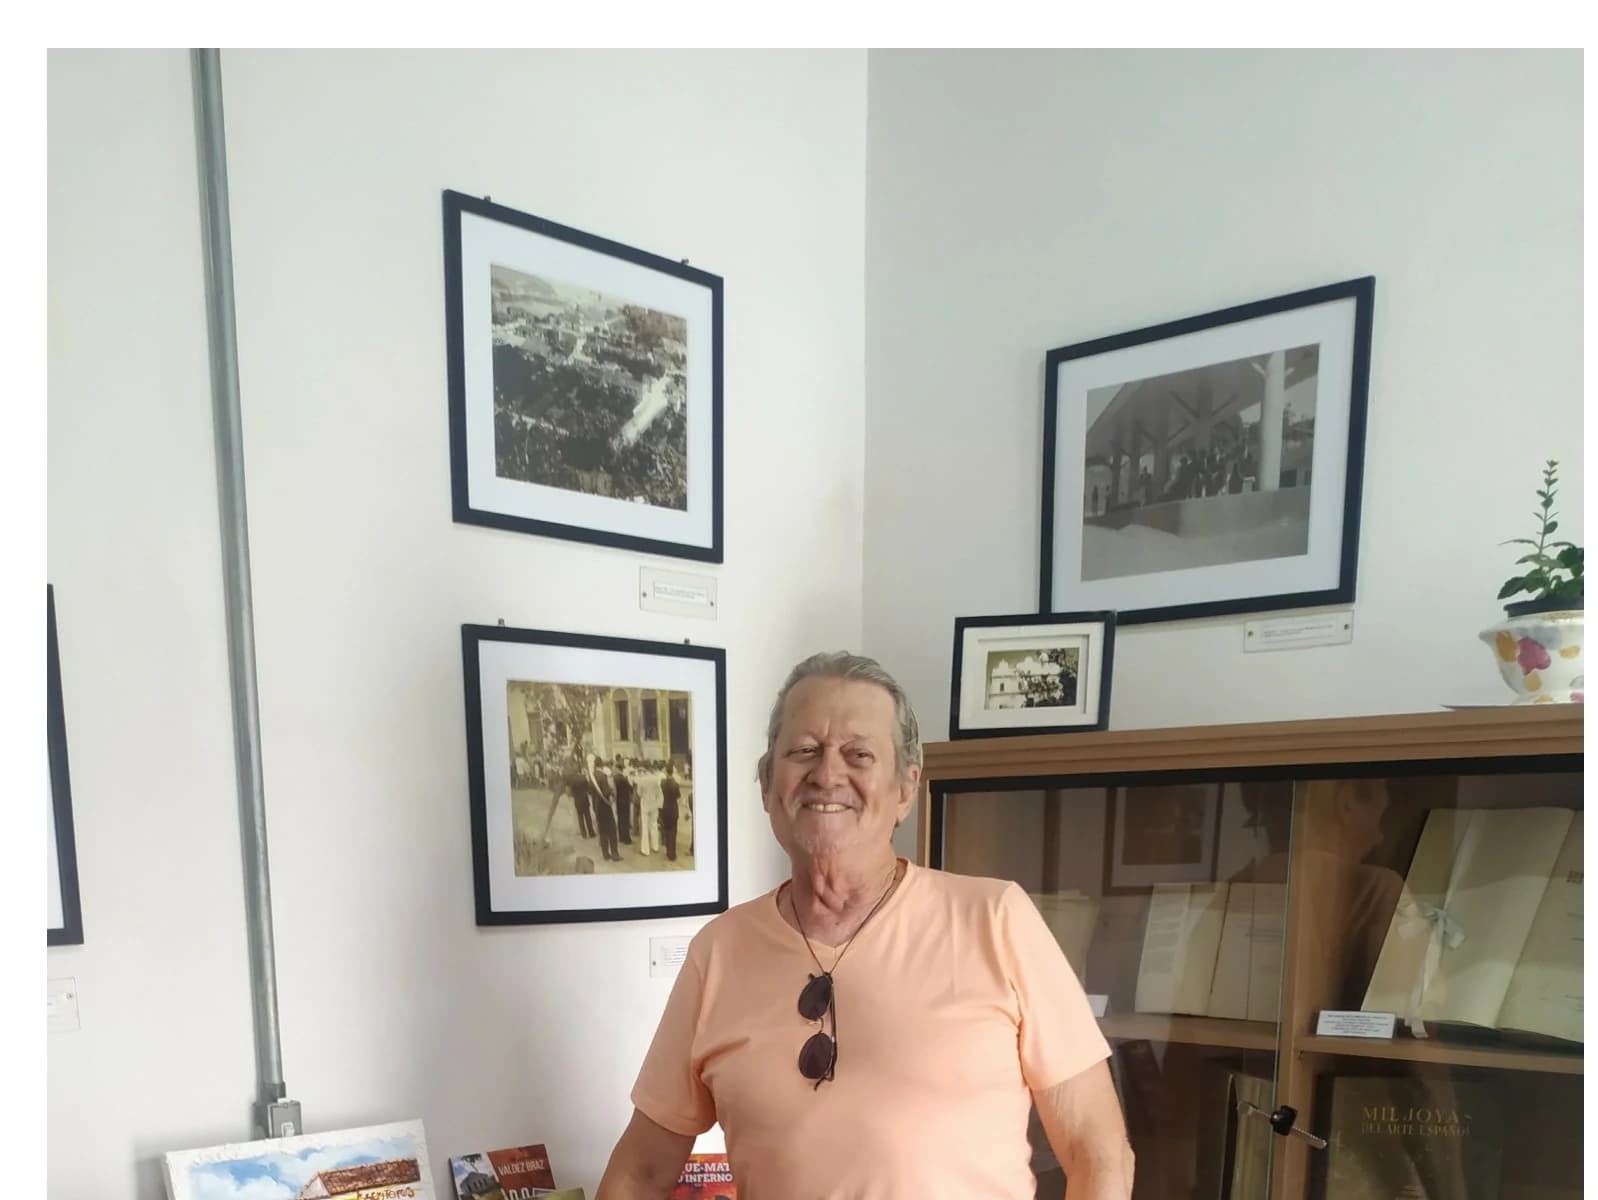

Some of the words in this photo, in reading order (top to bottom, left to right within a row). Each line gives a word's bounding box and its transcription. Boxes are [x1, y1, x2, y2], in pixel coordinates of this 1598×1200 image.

[1362, 1106, 1400, 1122] MIL
[498, 1163, 527, 1177] VALDEZ
[526, 1159, 546, 1172] BRAZ
[685, 1173, 733, 1184] INFERNO
